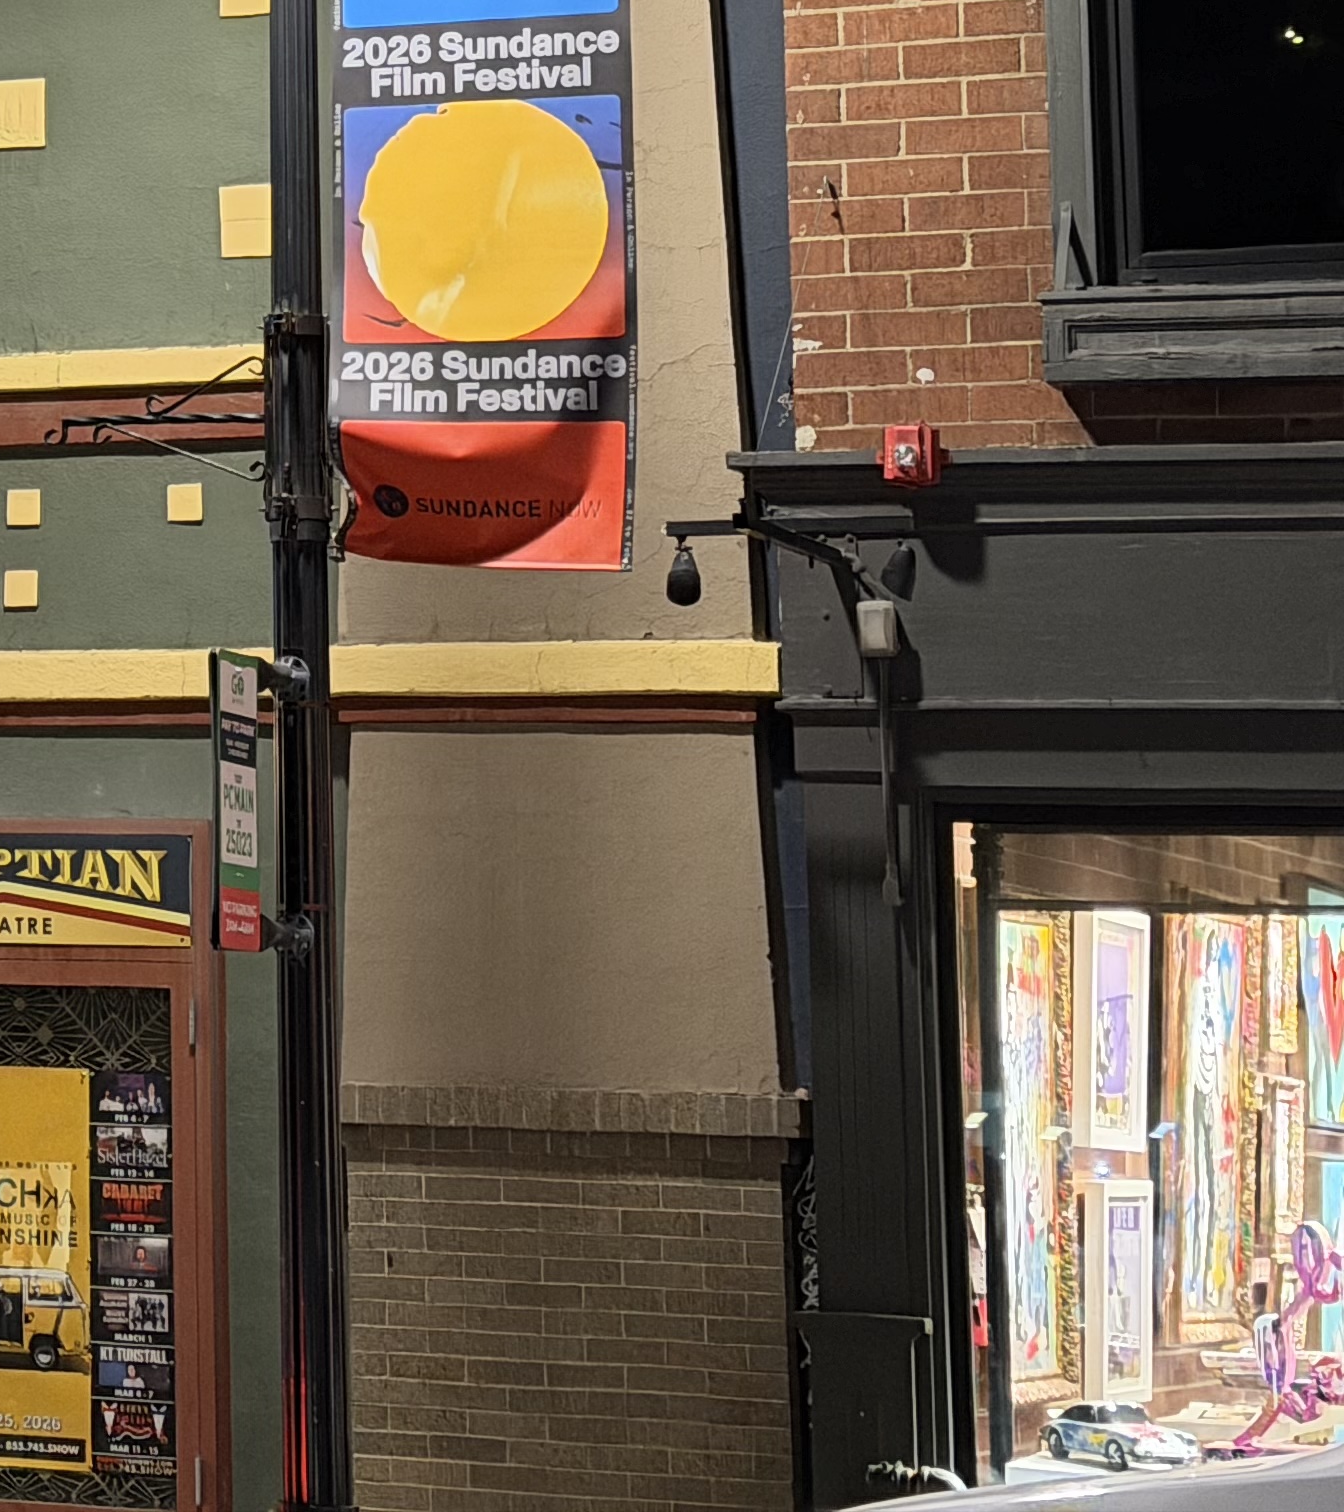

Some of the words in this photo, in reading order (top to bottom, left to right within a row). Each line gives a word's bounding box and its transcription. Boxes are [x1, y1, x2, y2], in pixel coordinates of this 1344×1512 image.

[342, 34, 431, 69] 2026
[438, 28, 621, 64] Sundance
[370, 64, 446, 99] Film
[453, 56, 593, 94] Festival
[341, 350, 434, 383] 2026
[443, 349, 627, 382] Sundance
[369, 382, 448, 413] Film
[457, 380, 599, 413] Festival
[415, 497, 542, 518] SUNDANCE
[548, 499, 602, 519] NOW
[226, 828, 253, 858] 25023
[101, 1182, 164, 1200] CABARET
[0, 1211, 50, 1226] MUSIC
[114, 1333, 146, 1343] MARCH
[99, 1346, 115, 1361] KT
[116, 1347, 168, 1364] TUNSTALL
[22, 1415, 62, 1432] 2026
